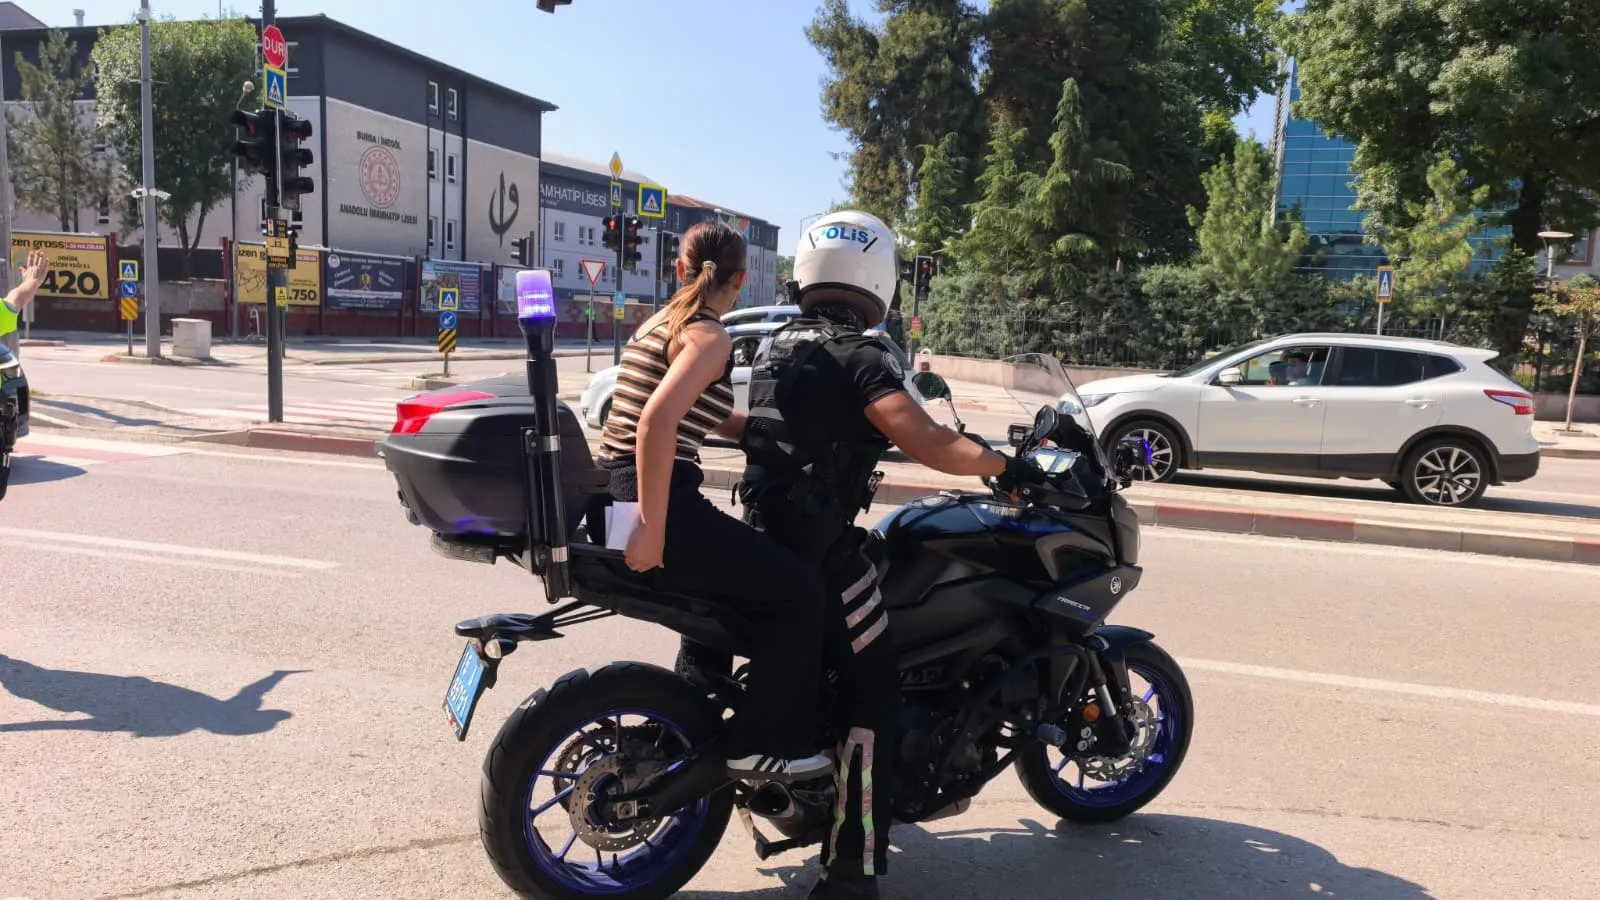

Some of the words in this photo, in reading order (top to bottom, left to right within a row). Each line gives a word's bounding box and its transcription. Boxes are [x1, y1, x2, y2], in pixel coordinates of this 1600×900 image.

[264, 36, 284, 56] DUR
[357, 130, 376, 144] BURSA
[340, 203, 368, 217] ANADOLU
[12, 238, 31, 247] zen
[33, 239, 64, 250] gross
[39, 270, 100, 295] 420
